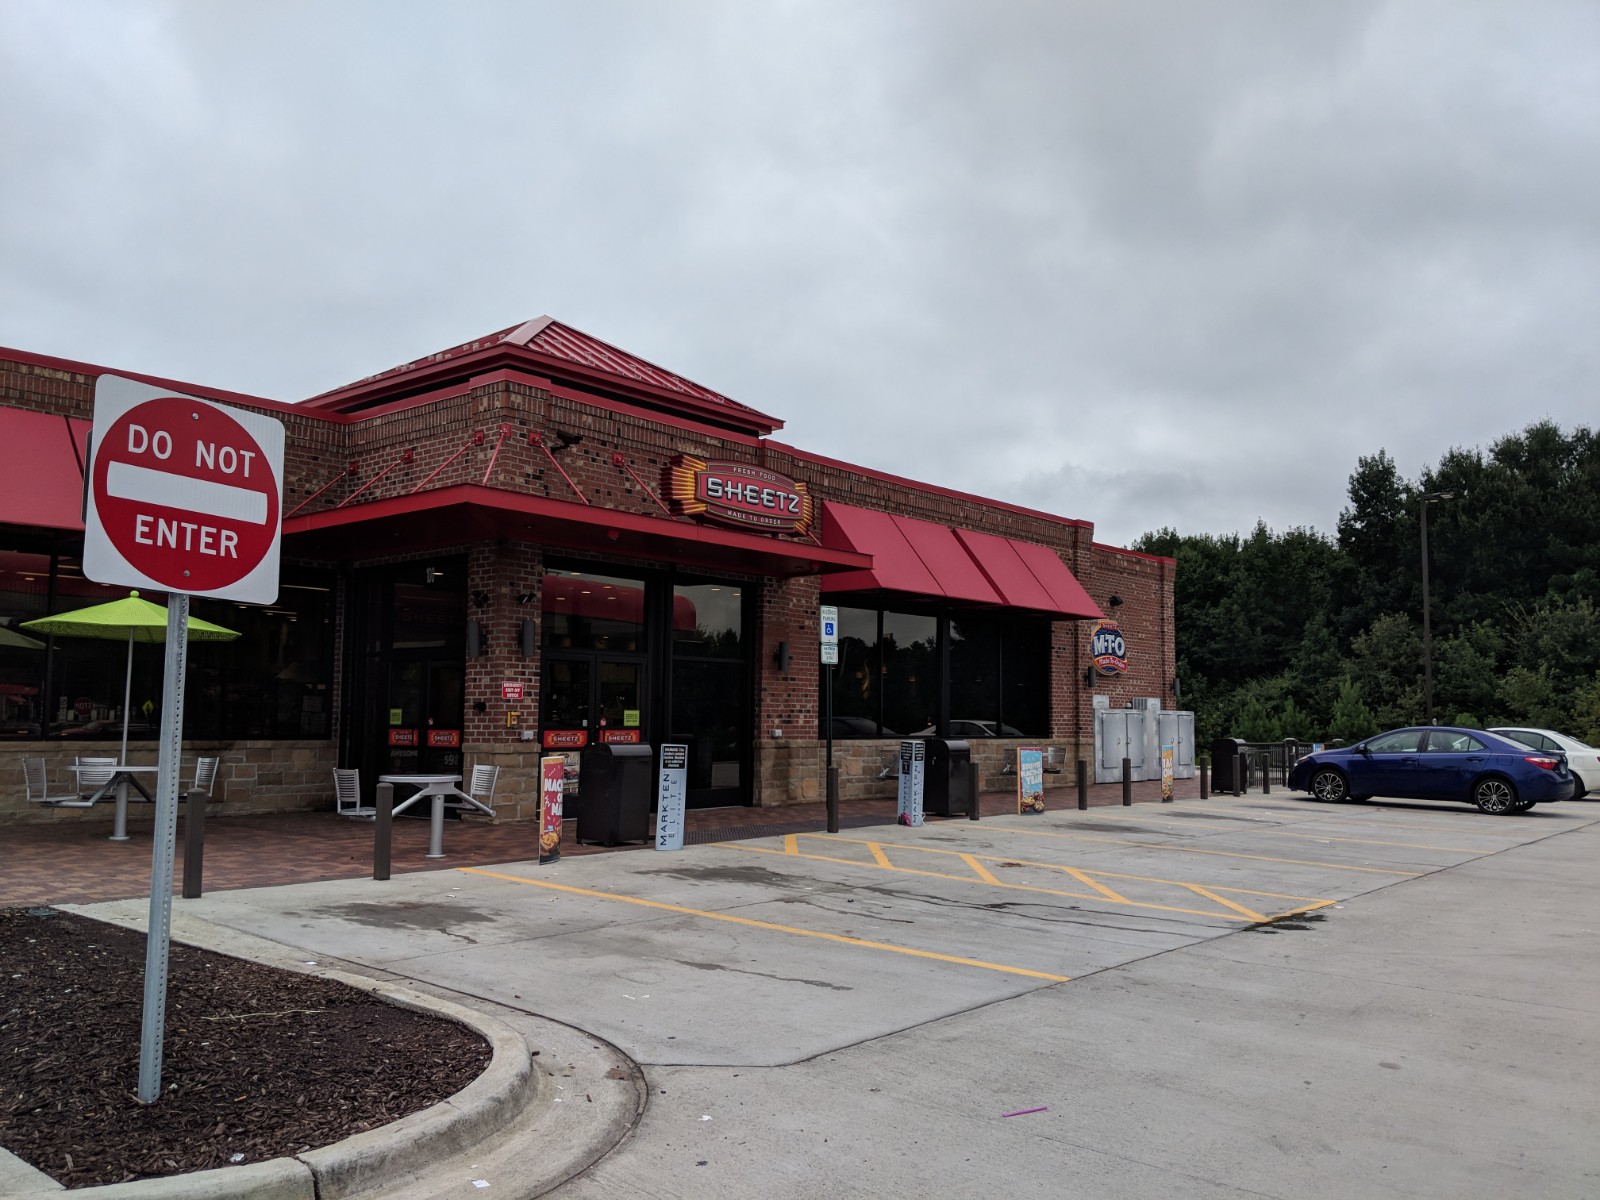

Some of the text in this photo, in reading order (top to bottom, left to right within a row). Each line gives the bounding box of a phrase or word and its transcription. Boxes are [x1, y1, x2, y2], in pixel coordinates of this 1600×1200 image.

[127, 423, 257, 478] DO NOT
[706, 477, 801, 514] SHEETZ
[733, 467, 776, 482] FRESH FOOD
[135, 514, 239, 559] ENTER
[727, 510, 781, 525] MADE TO ORDER
[659, 773, 670, 846] MARKTEN
[668, 779, 678, 838] ELITE
